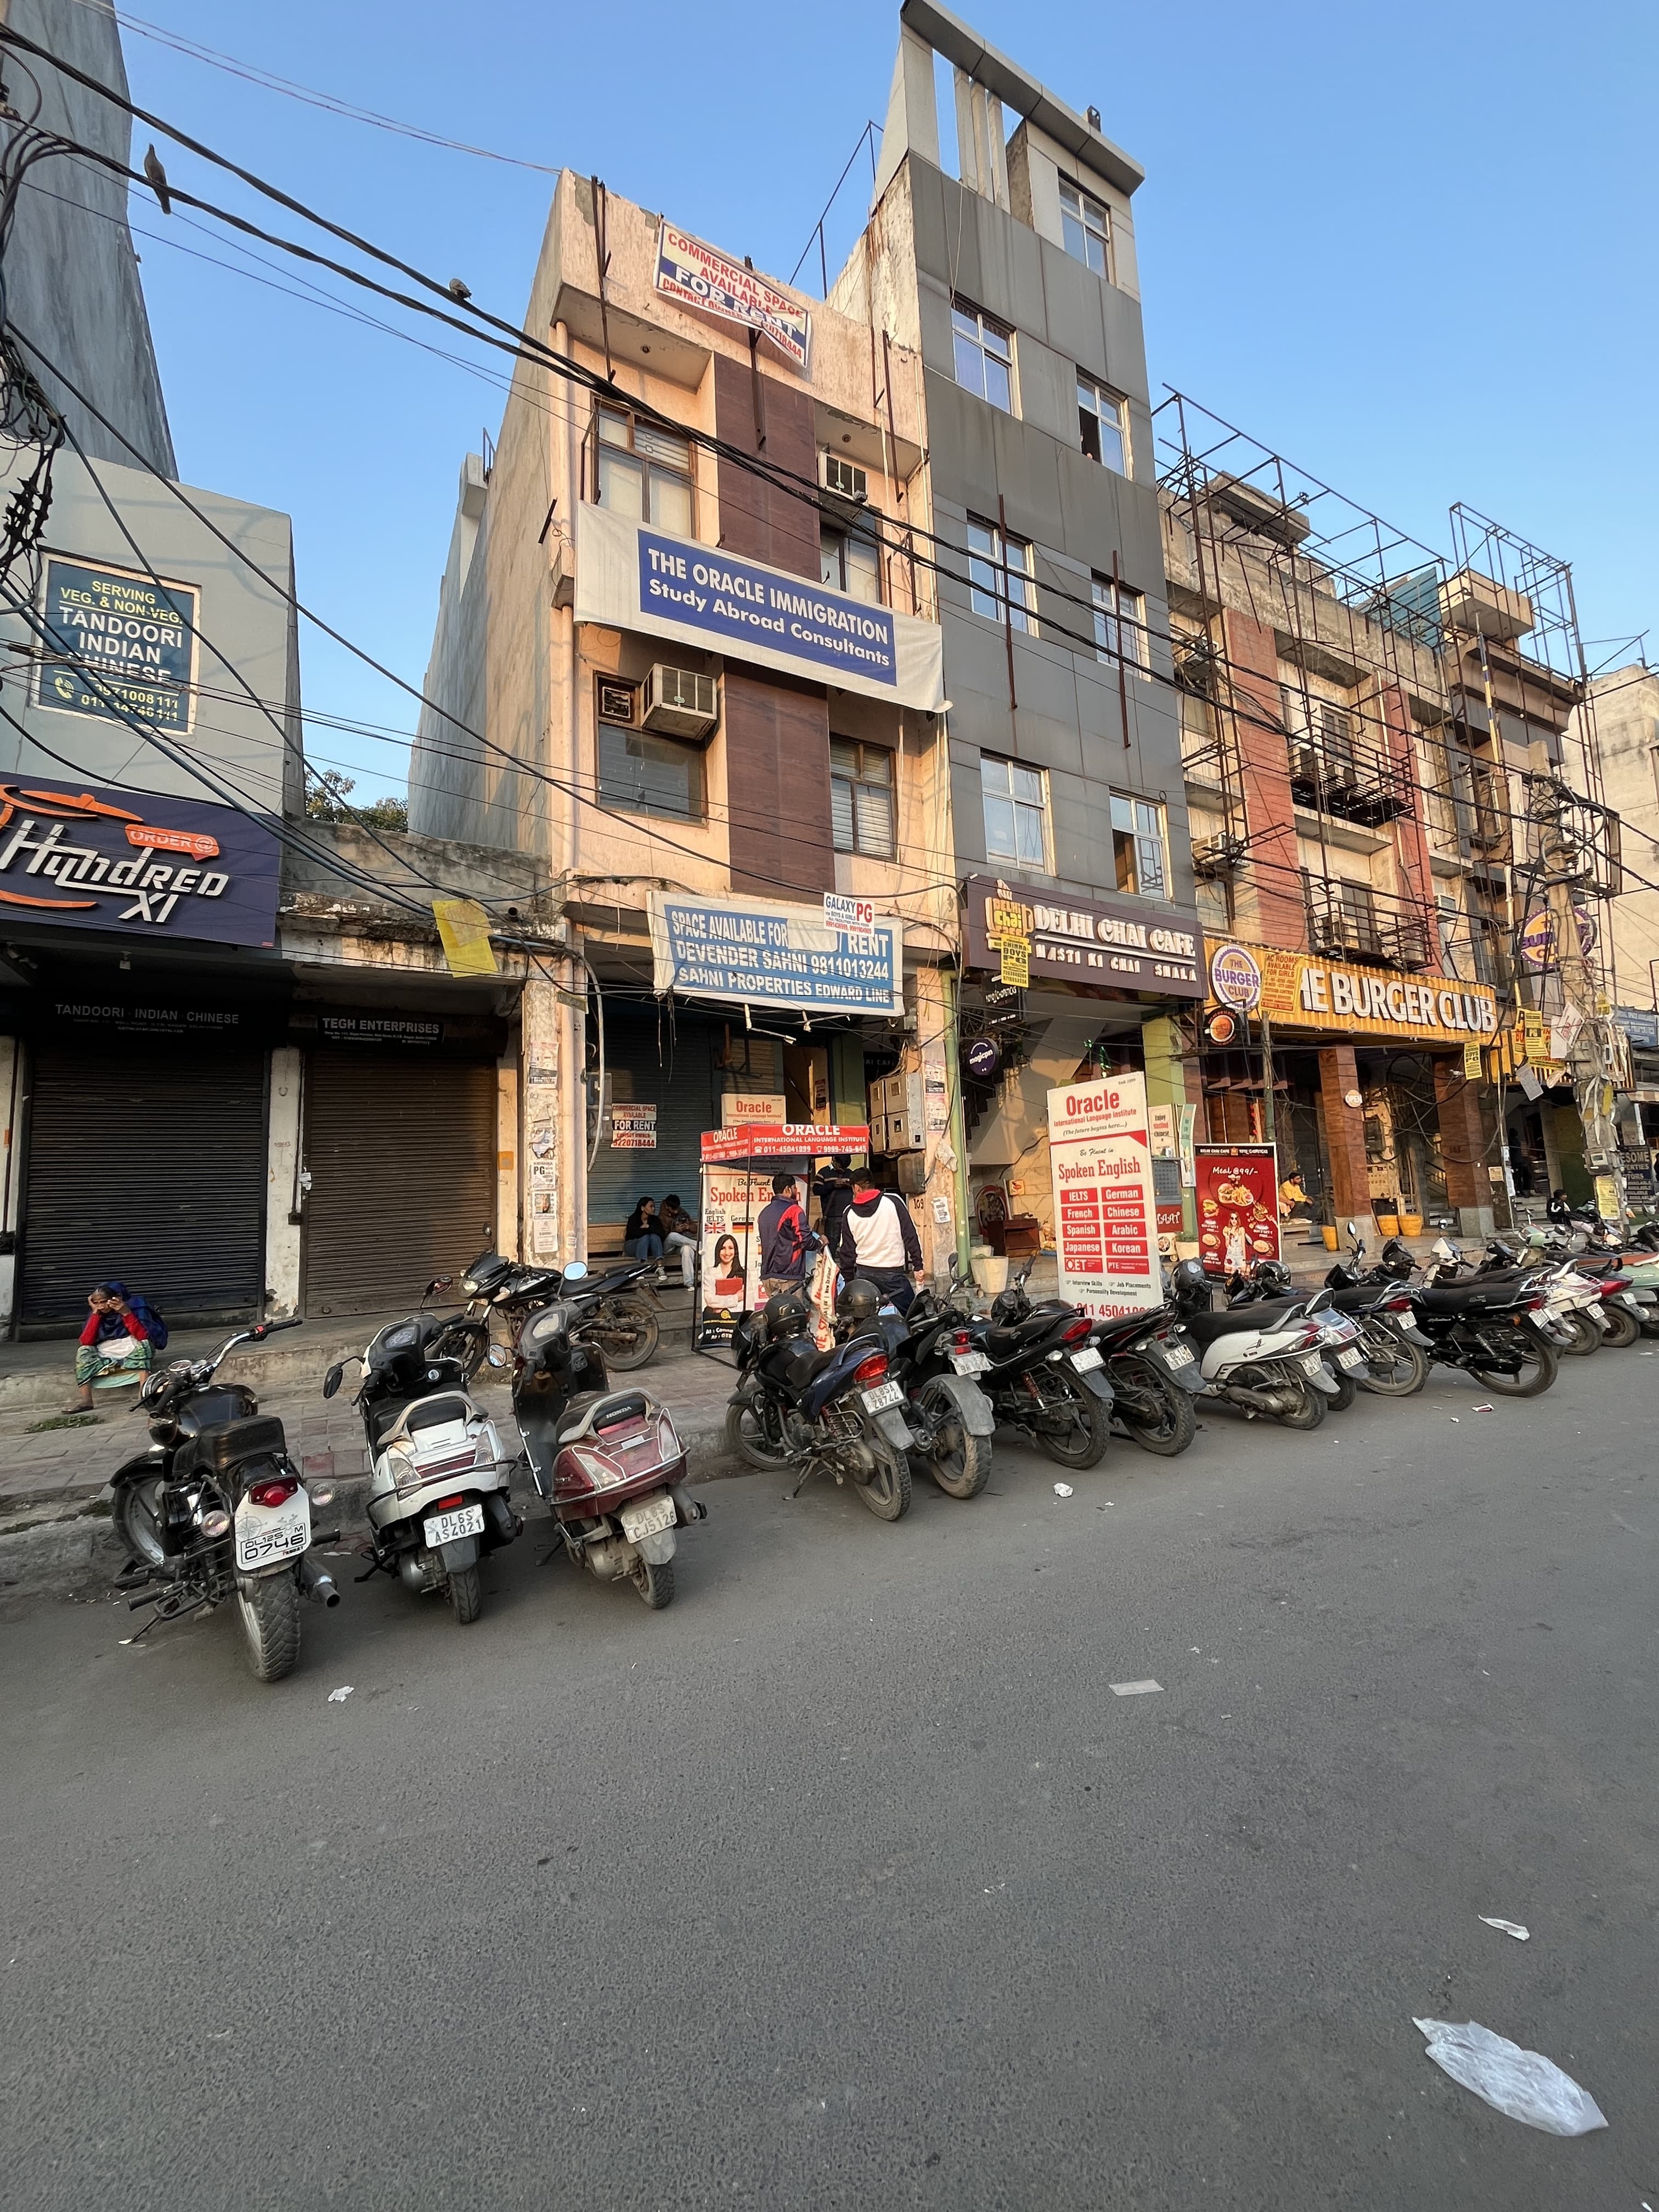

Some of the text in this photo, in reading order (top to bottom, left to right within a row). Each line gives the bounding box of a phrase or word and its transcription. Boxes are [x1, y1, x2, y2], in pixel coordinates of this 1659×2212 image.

[668, 232, 803, 319] COMMERCIAL SPACE
[700, 266, 773, 316] AVAILABLE
[675, 266, 797, 338] FOR RENT
[91, 580, 156, 605] SERVING
[647, 548, 889, 645] THE ORACLE IMMIGRATION
[60, 586, 183, 625] VEG. & NON-VEG.
[58, 605, 183, 649] TANDOORI
[648, 579, 890, 667] Study Abroad Consultants
[78, 631, 161, 665] INDIAN
[129, 828, 192, 849] ORDER
[117, 892, 182, 923] XI
[826, 895, 872, 923] GALAXY PG
[671, 911, 889, 957] SPACE AVAILABLE FOR RENT
[1033, 904, 1196, 958] DELHI CHAI CAFE
[675, 939, 889, 980] DEVENDER SAHNI 9811013244
[1003, 947, 1026, 958] BOYS
[1276, 956, 1299, 964] ROOMS
[1087, 952, 1104, 968] KI
[1110, 956, 1140, 973] CHAI
[1229, 959, 1244, 969] THE
[1267, 962, 1295, 971] AVAILABLE
[1214, 968, 1260, 988] BURGER
[1278, 969, 1295, 978] GIRLS
[679, 966, 890, 1004] SAHNI PROPERTIES EDWARD LINE
[1228, 985, 1250, 998] CLUB
[1330, 972, 1436, 1026] BURGER
[1437, 990, 1498, 1032] CLUB
[54, 1004, 125, 1018] TANDOORI
[134, 1008, 178, 1021] INDIAN
[186, 1011, 240, 1025] CHINESE
[322, 1018, 440, 1034] TEGH ENTERPRISES
[969, 1049, 994, 1065] magicpin
[736, 1101, 772, 1114] Oracle
[1066, 1088, 1120, 1117] Oracle
[614, 1120, 656, 1131] FOR RENT
[1053, 1108, 1137, 1127] International Language Institute
[713, 1127, 738, 1143] ORACLE
[781, 1124, 840, 1136] ORACLE
[1074, 1127, 1090, 1136] future
[1090, 1124, 1108, 1133] begins
[613, 1139, 655, 1147] 9220718444
[763, 1145, 811, 1153] 011-45041999
[1088, 1148, 1107, 1157] Fluent
[1620, 1151, 1650, 1163] ESOME
[533, 1166, 546, 1175] PG
[1058, 1156, 1142, 1183] Spoken English
[1212, 1166, 1232, 1175] Meal
[737, 1178, 771, 1187] Be Fluent
[710, 1186, 755, 1206] Spoken
[1068, 1187, 1139, 1201] IELTS German
[913, 1198, 924, 1210] 109
[1067, 1206, 1140, 1218] French Chinese
[1066, 1224, 1138, 1237] Spanish Arabic
[1065, 1241, 1141, 1254] Japanese Korean
[1065, 1258, 1087, 1271] OET
[868, 1384, 895, 1401] DL8SA
[872, 1391, 900, 1409] Z8744
[605, 1406, 633, 1419] HONDA
[441, 1509, 473, 1529] DL6S
[245, 1531, 284, 1549] DL12S
[435, 1519, 482, 1544] AS4021
[245, 1532, 304, 1560] 0746
